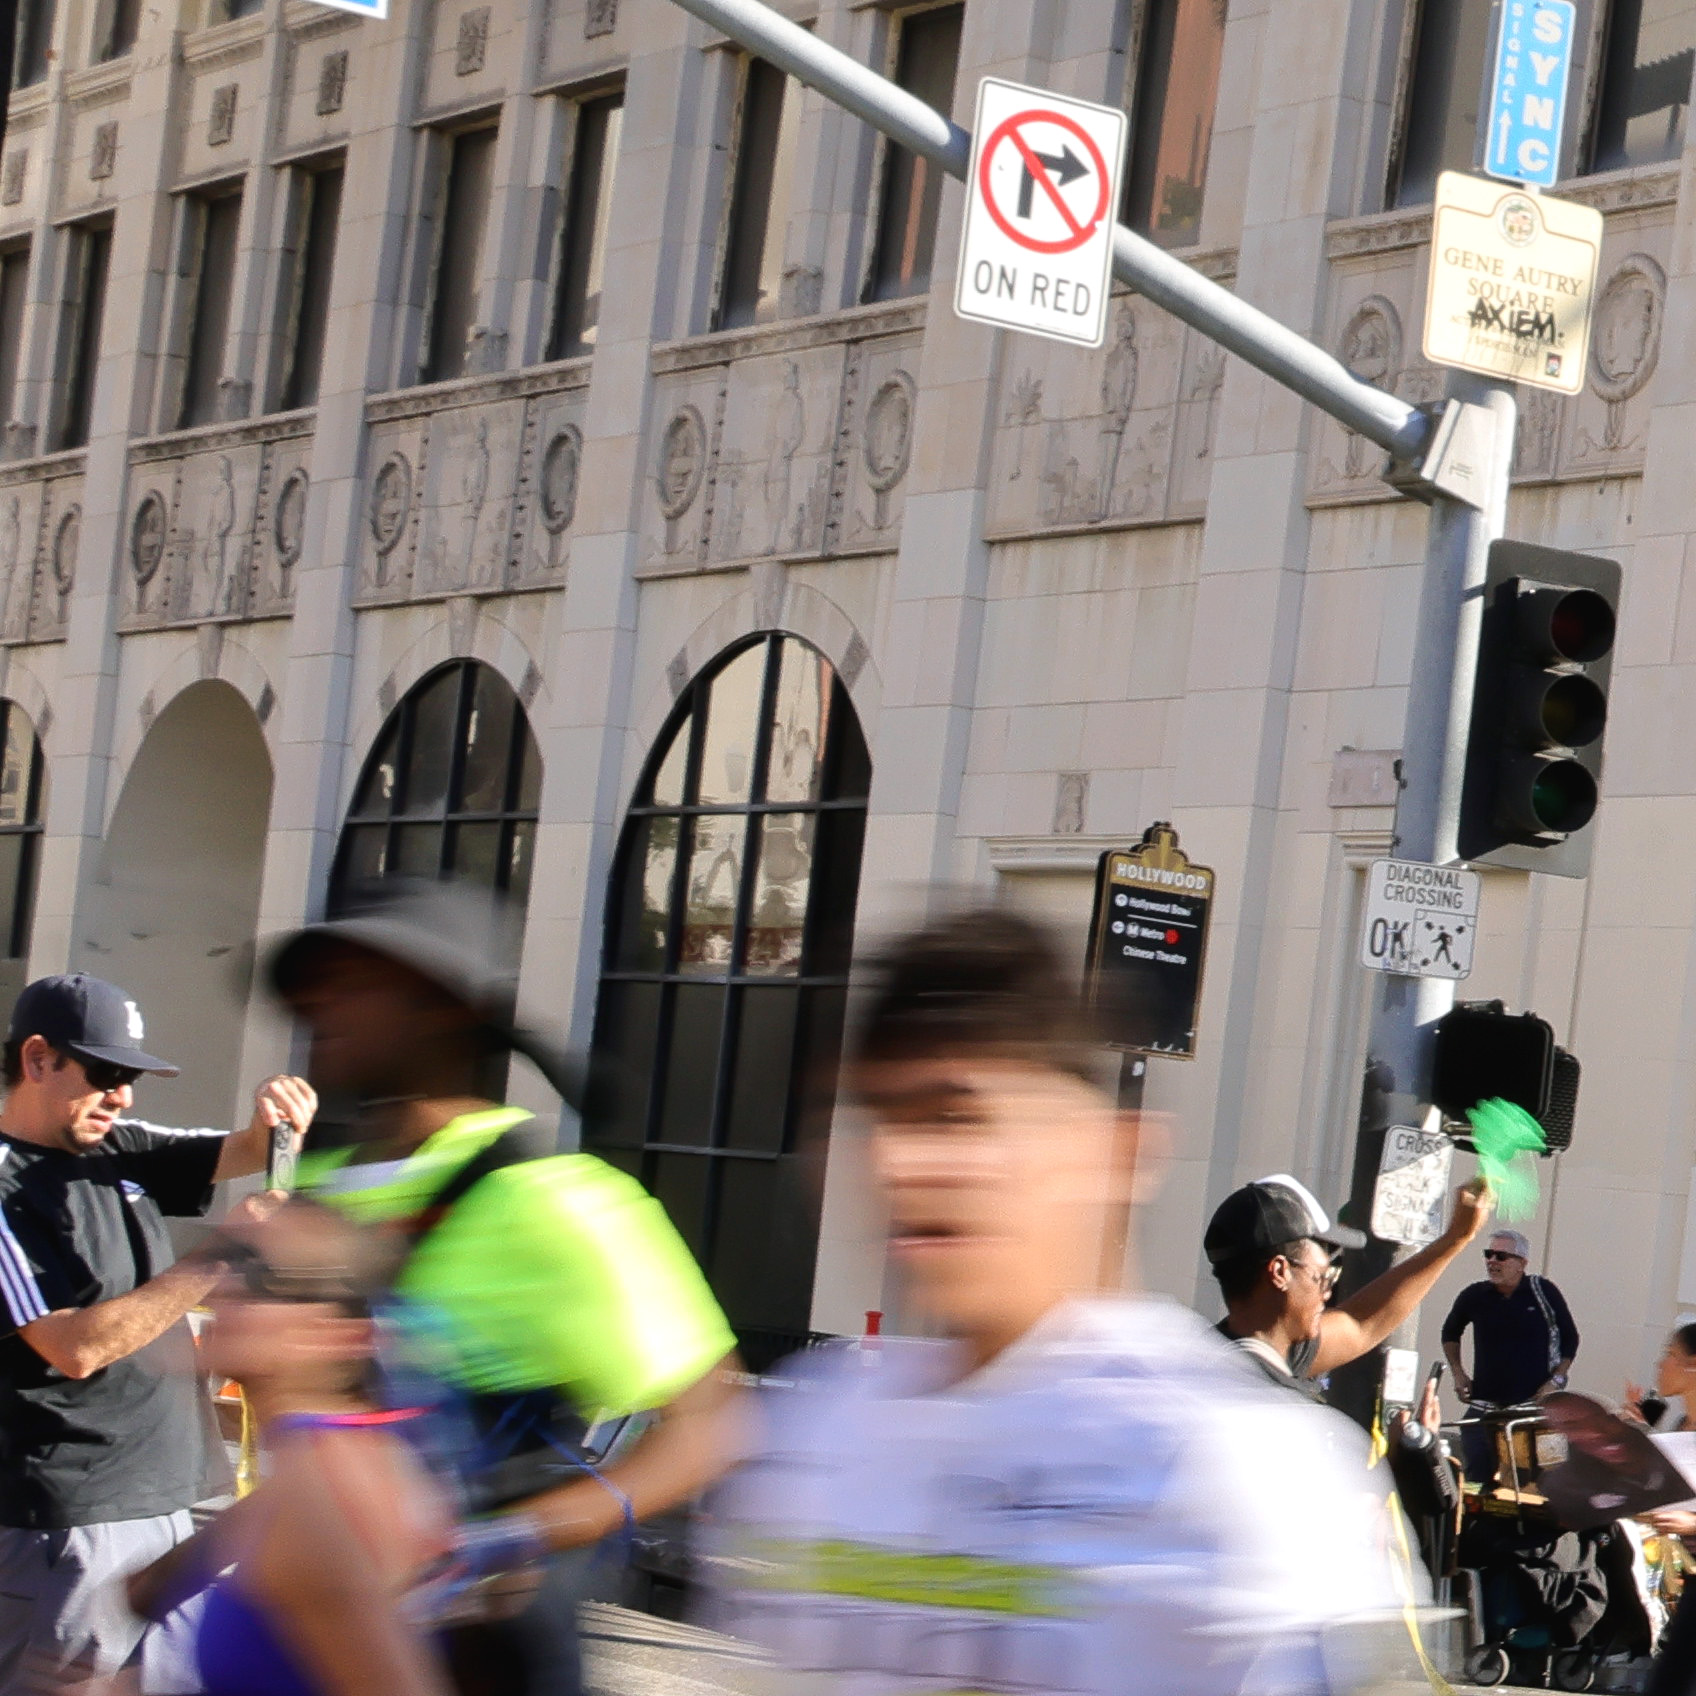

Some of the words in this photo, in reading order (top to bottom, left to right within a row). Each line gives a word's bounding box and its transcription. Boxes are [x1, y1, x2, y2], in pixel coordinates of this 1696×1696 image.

[1503, 3, 1524, 104] SIGNAL
[1518, 10, 1563, 172] SYNC
[974, 260, 1017, 300] ON
[1030, 272, 1091, 316] RED
[1444, 248, 1504, 277] GENE
[1513, 265, 1583, 297] AUTRY
[1467, 277, 1554, 314] SQUARE
[1116, 862, 1207, 891] HOLLYWOOD
[1383, 883, 1463, 909] CROSSING
[1387, 864, 1464, 890] DIAGONAL
[1370, 917, 1411, 960] OK
